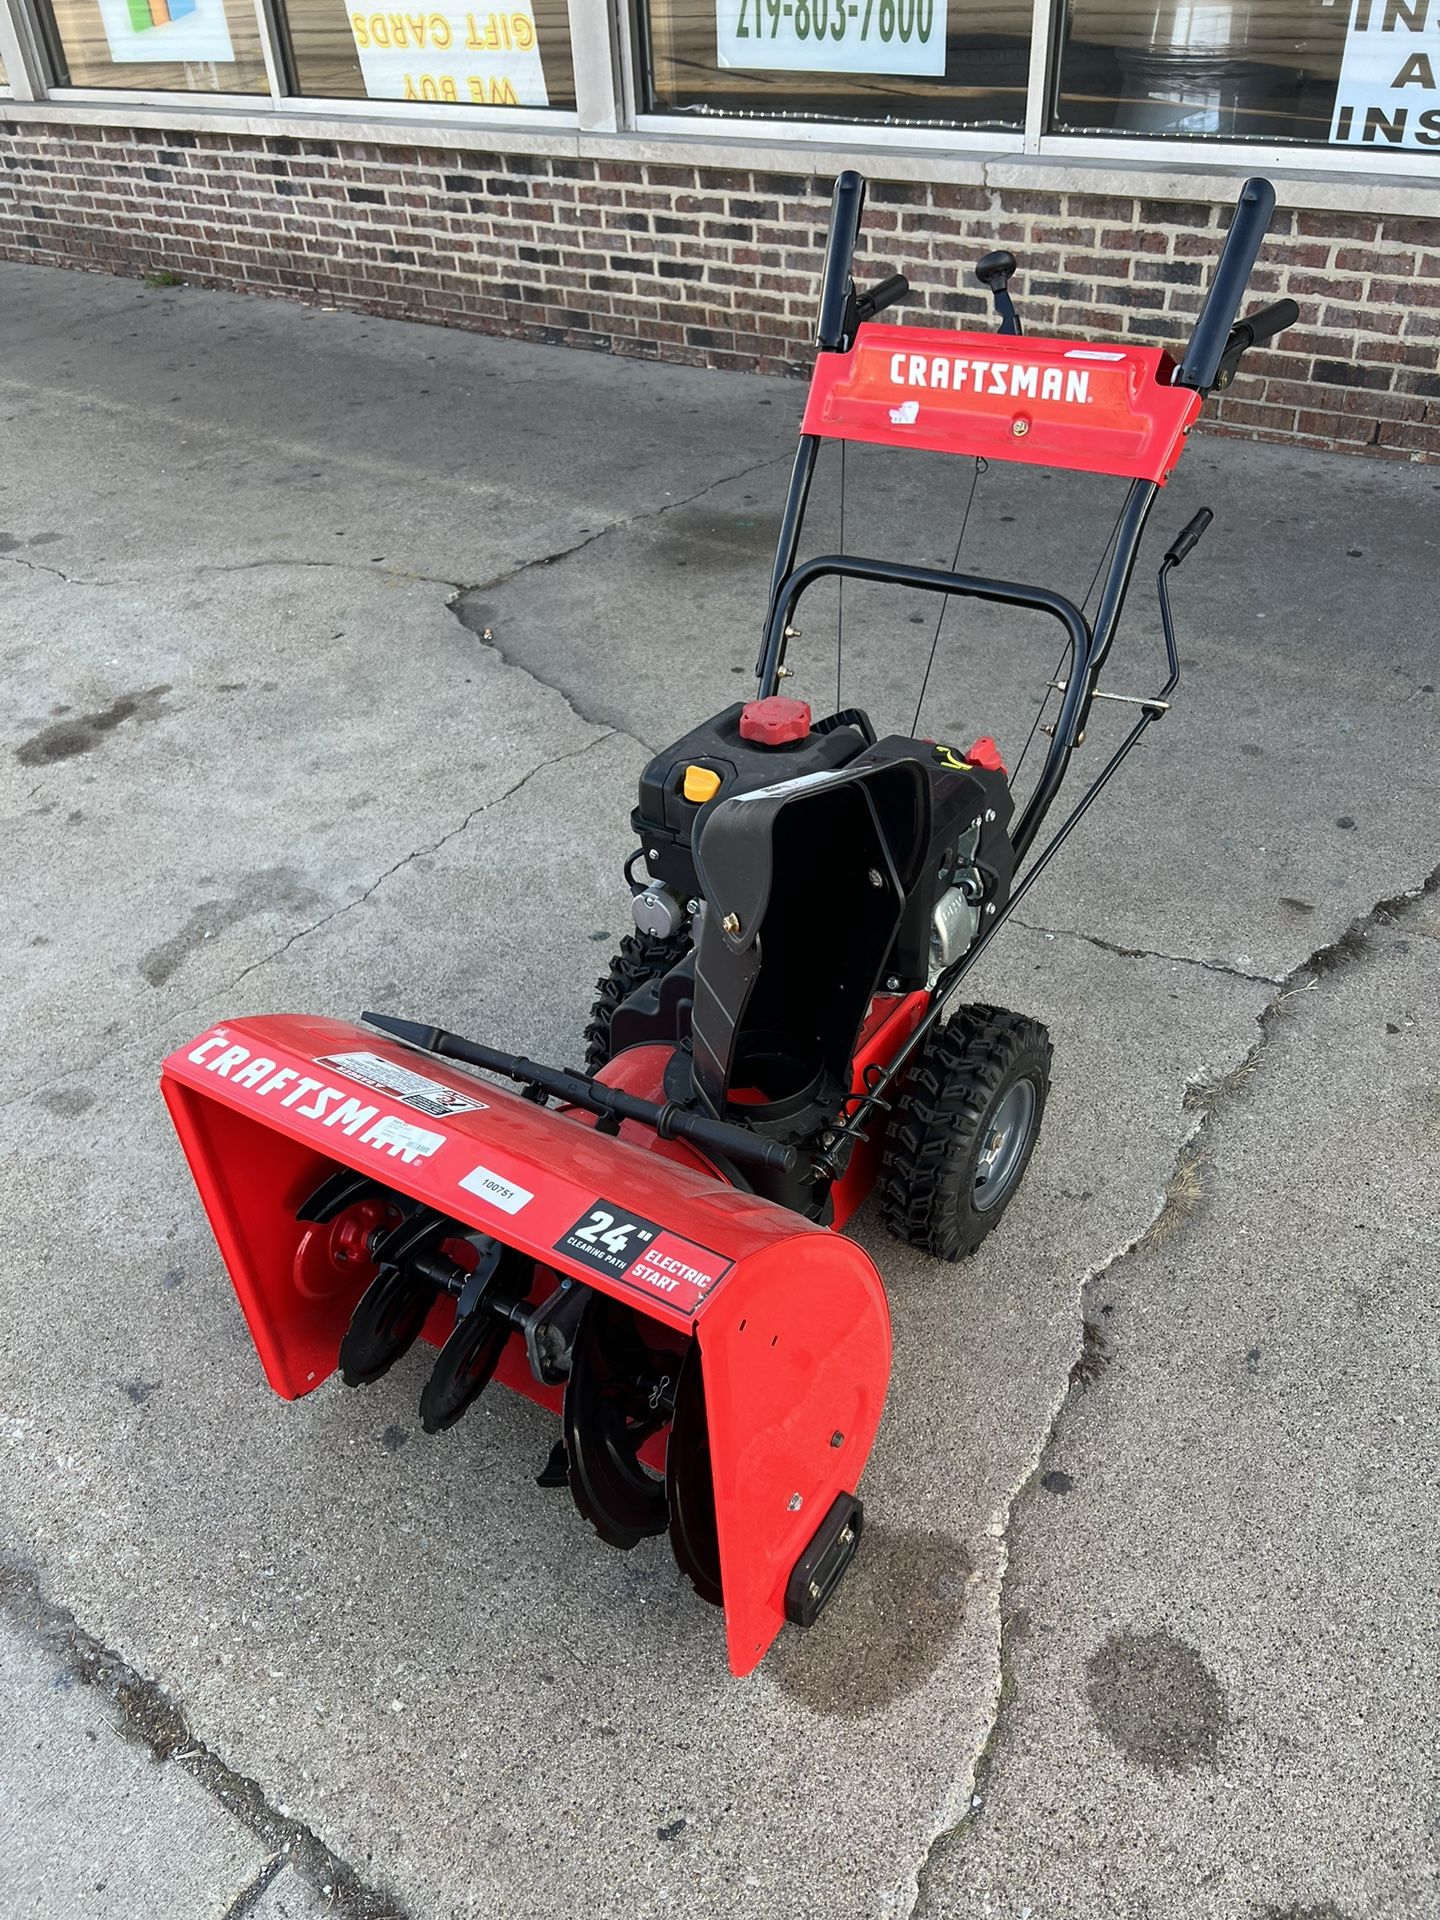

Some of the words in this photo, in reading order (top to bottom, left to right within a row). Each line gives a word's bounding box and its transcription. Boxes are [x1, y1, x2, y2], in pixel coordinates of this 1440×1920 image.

[351, 12, 452, 49] CARDS
[465, 12, 536, 52] GIFT
[736, 0, 933, 43] 219-803-7600
[1354, 0, 1440, 32] IN
[404, 73, 459, 102] BUY
[467, 76, 519, 105] WE
[890, 353, 1089, 403] CRAFTSMAN
[482, 1178, 514, 1200] 100751
[567, 1236, 604, 1260] CLEARING
[605, 1254, 628, 1269] PATH
[645, 1249, 711, 1288] ELECTRIC
[632, 1265, 680, 1292] START
